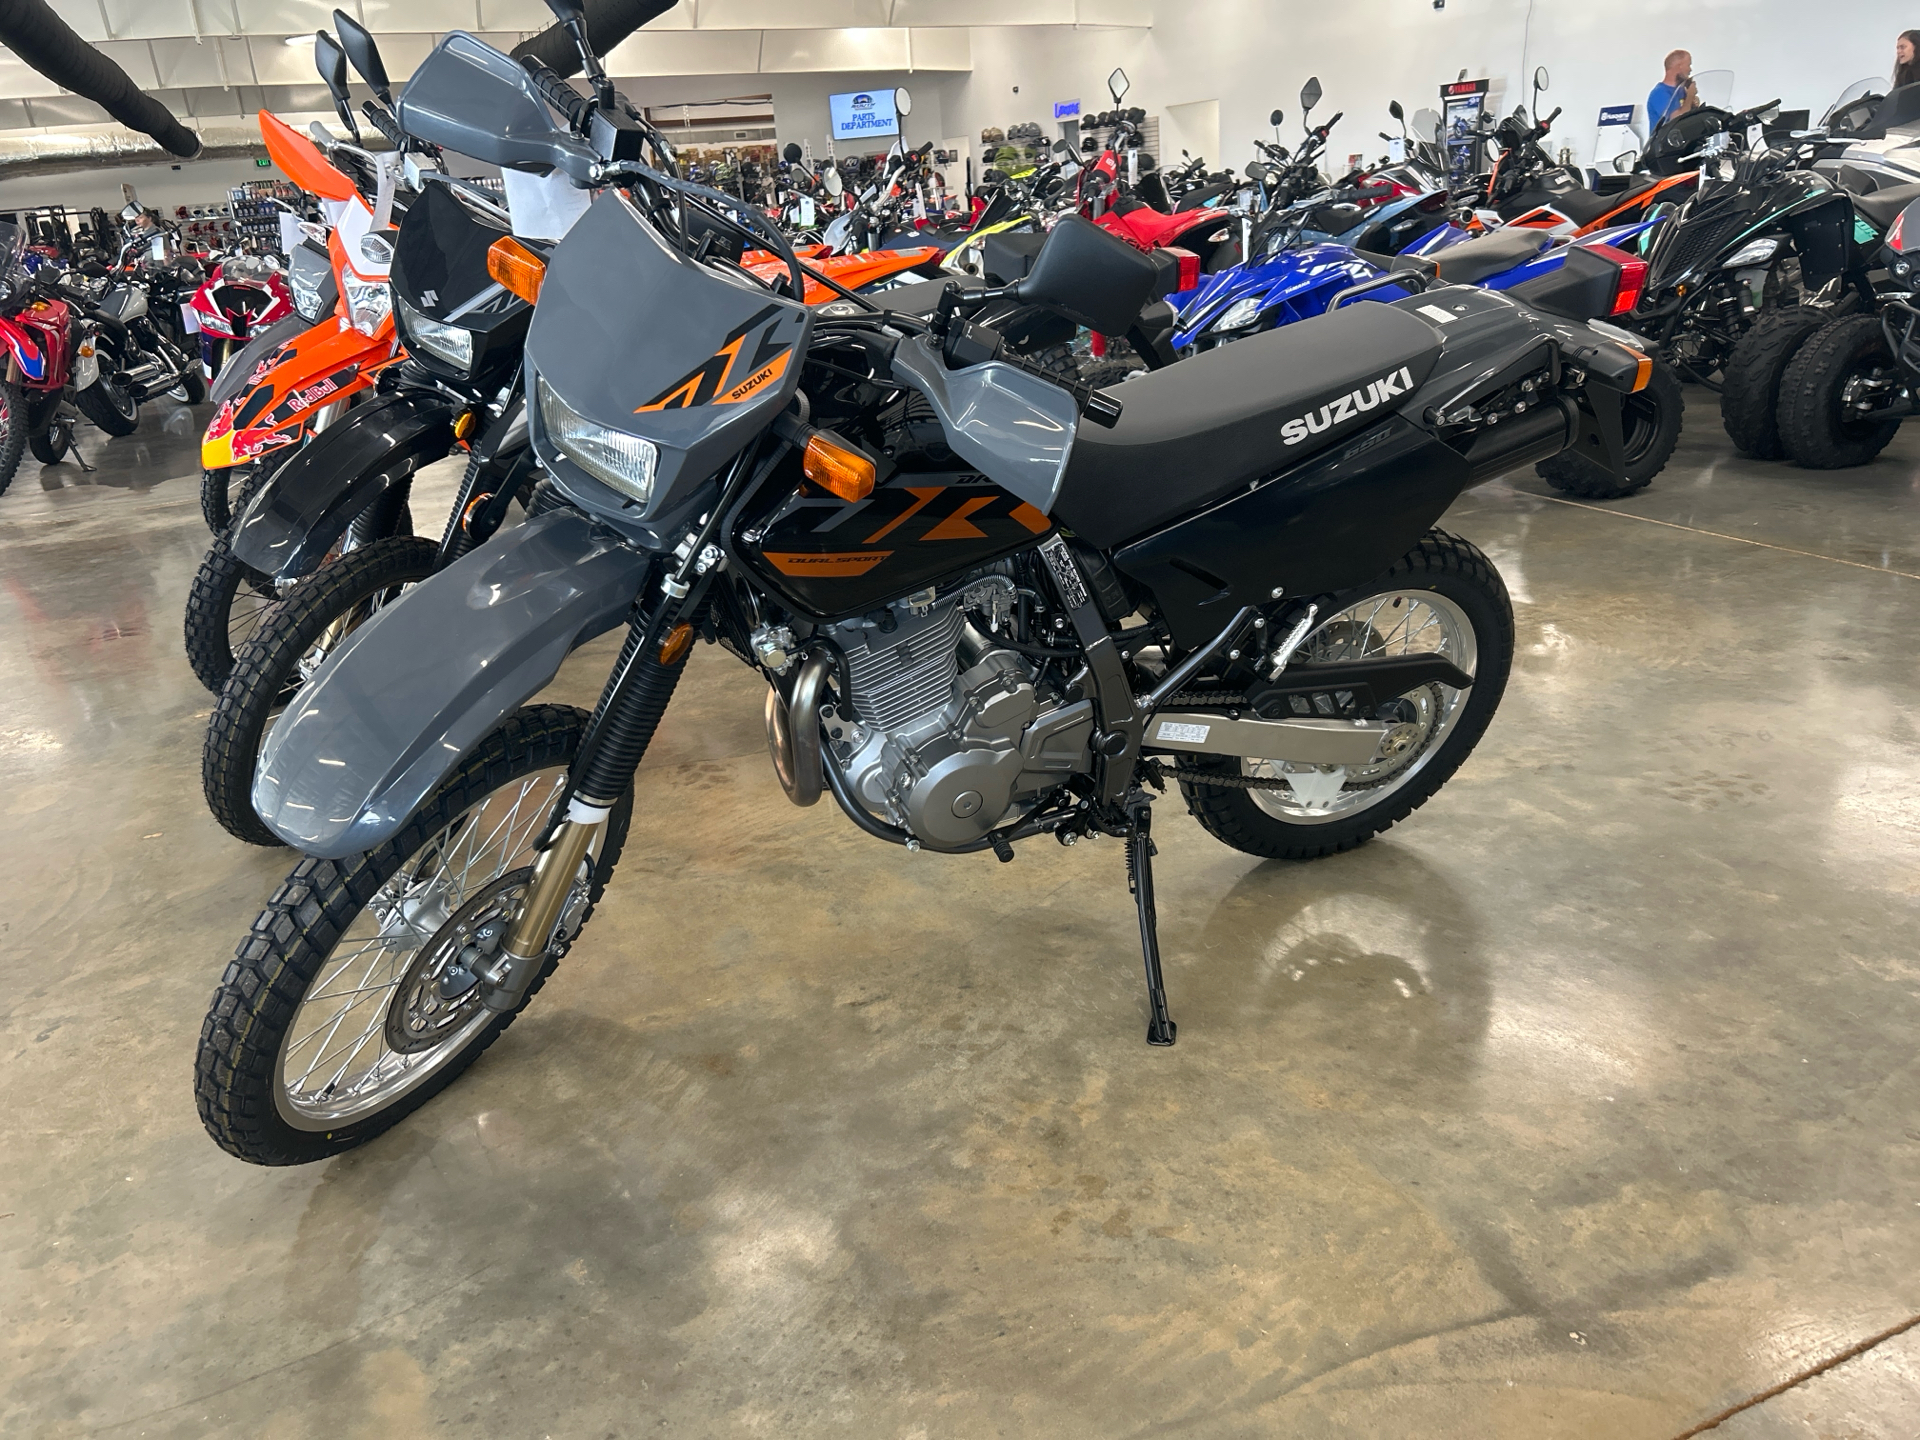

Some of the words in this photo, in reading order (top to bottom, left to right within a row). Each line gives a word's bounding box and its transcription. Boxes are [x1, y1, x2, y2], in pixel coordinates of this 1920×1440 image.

[841, 118, 893, 131] DEPARTMENT
[852, 112, 876, 122] PARTS
[732, 368, 773, 400] SUZUKI
[1280, 366, 1414, 446] SUZUKI
